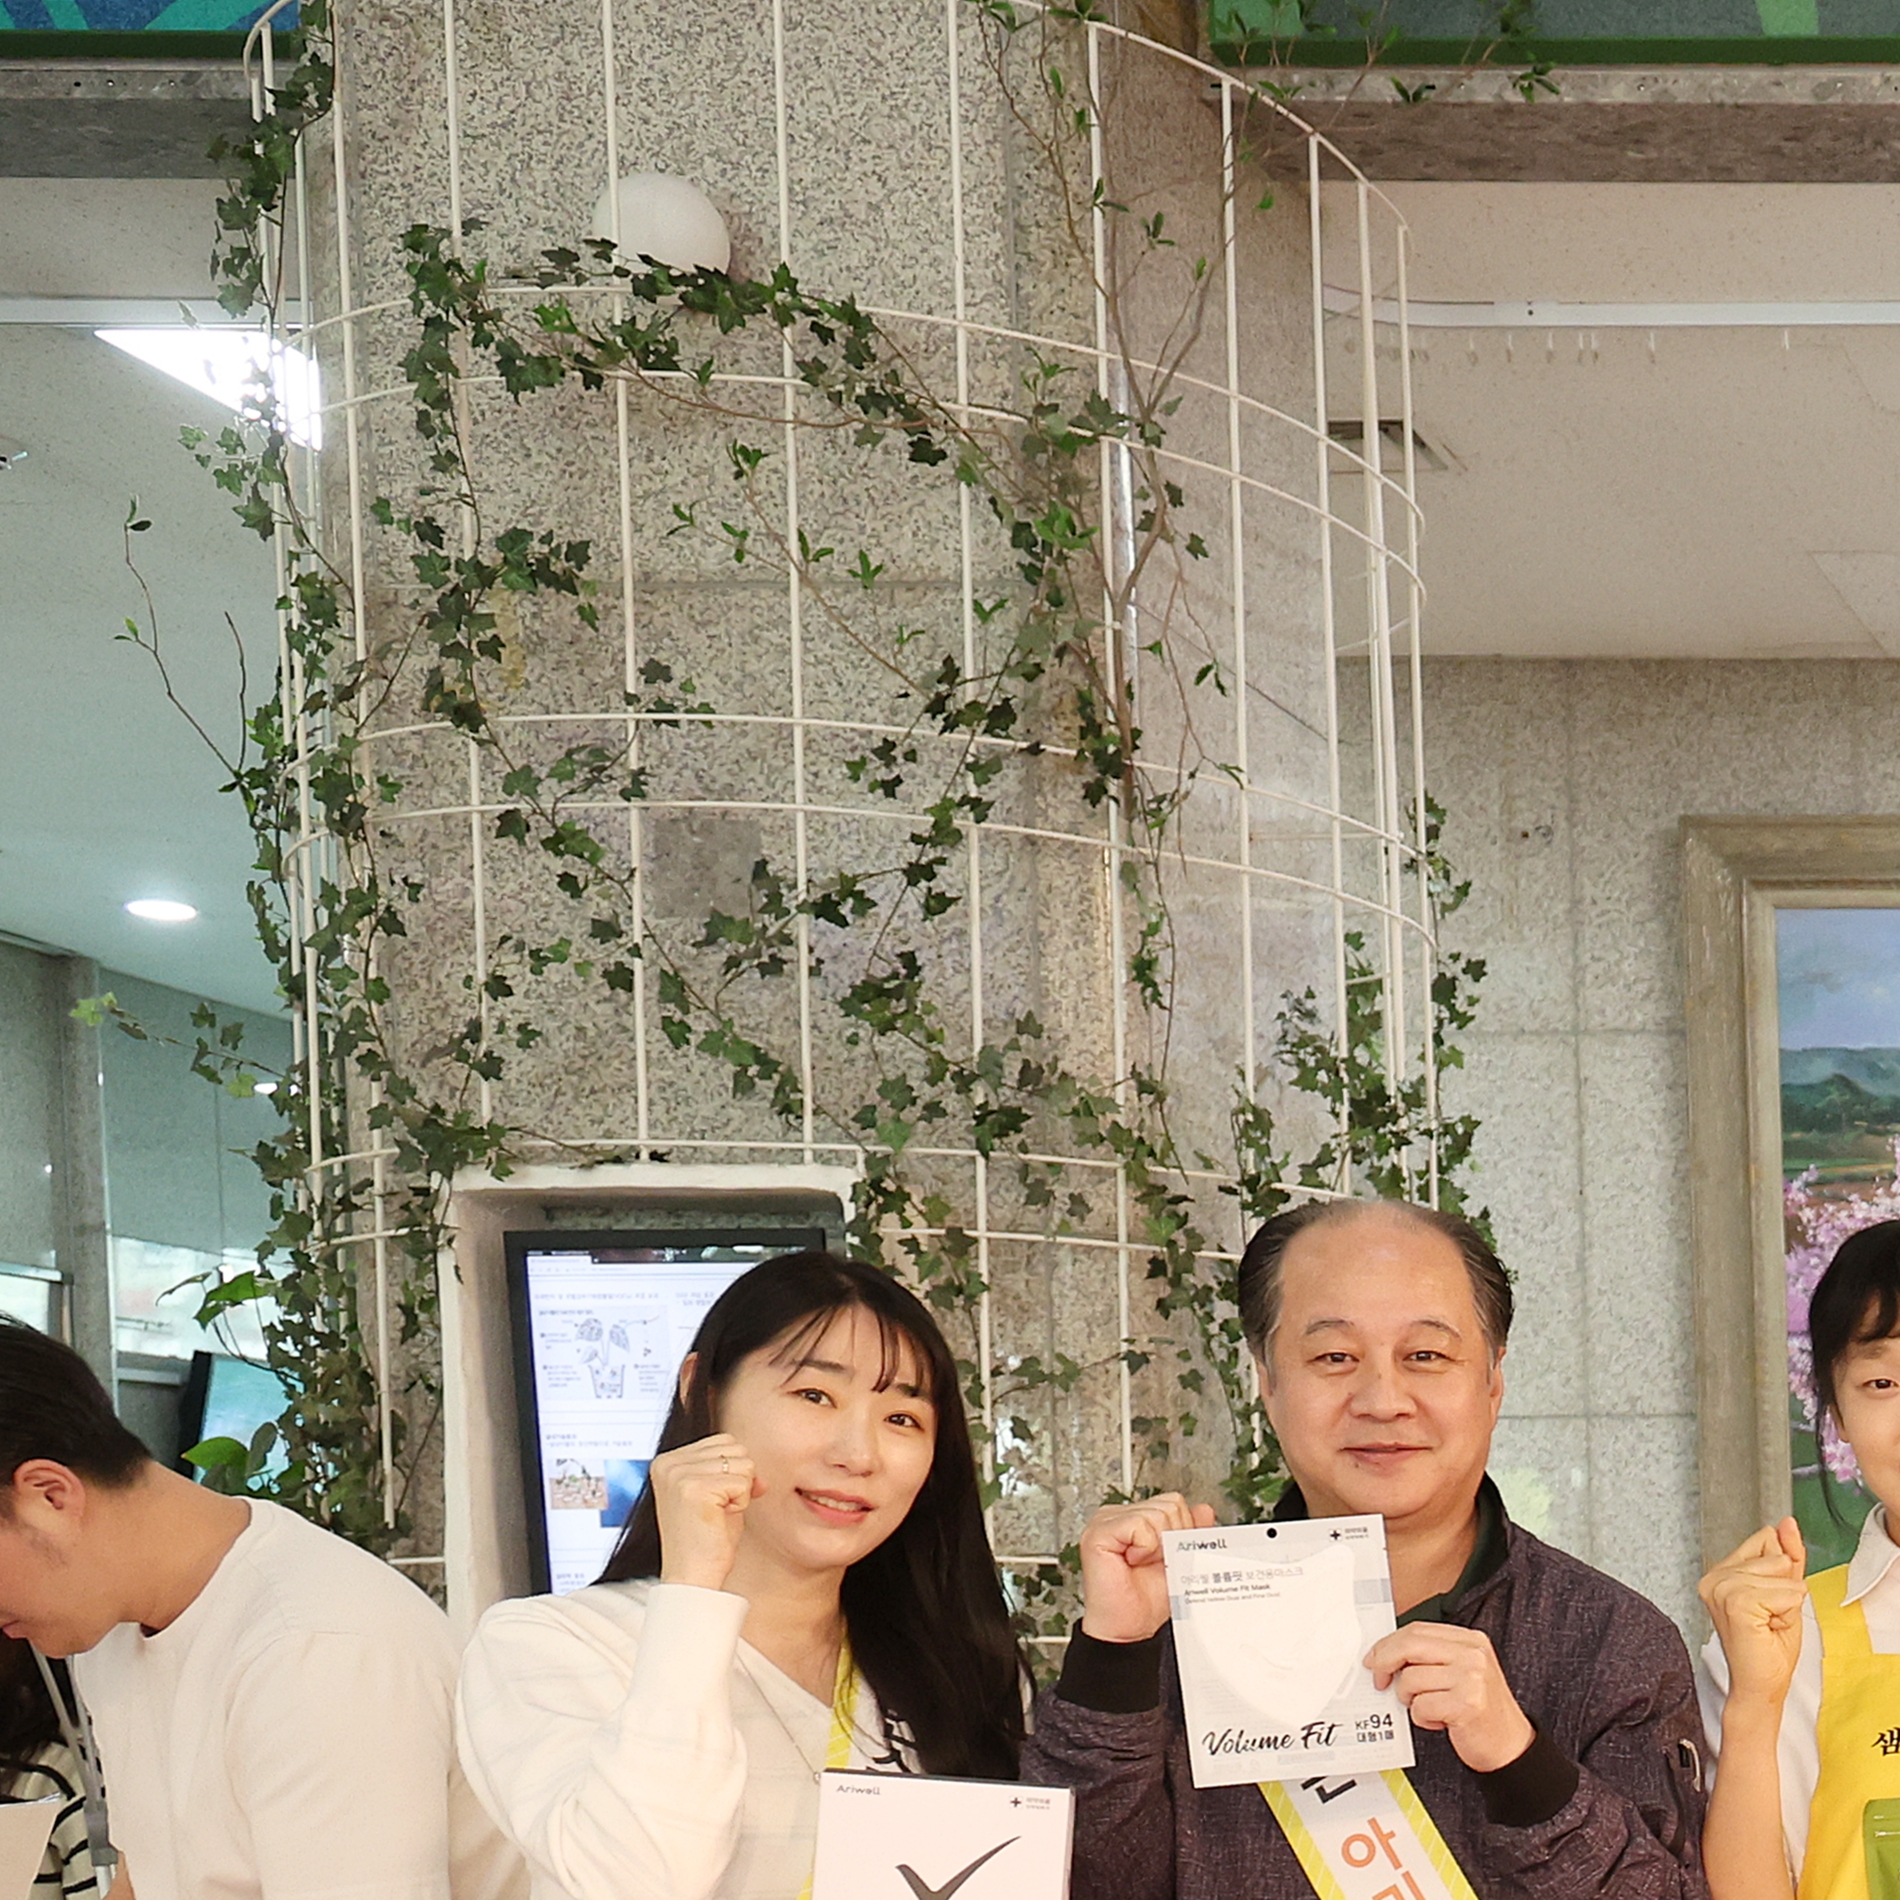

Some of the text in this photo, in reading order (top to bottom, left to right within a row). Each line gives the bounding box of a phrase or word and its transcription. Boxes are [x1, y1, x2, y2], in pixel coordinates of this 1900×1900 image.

[1355, 1713, 1393, 1731] KF94
[1201, 1720, 1344, 1756] Volume Fit
